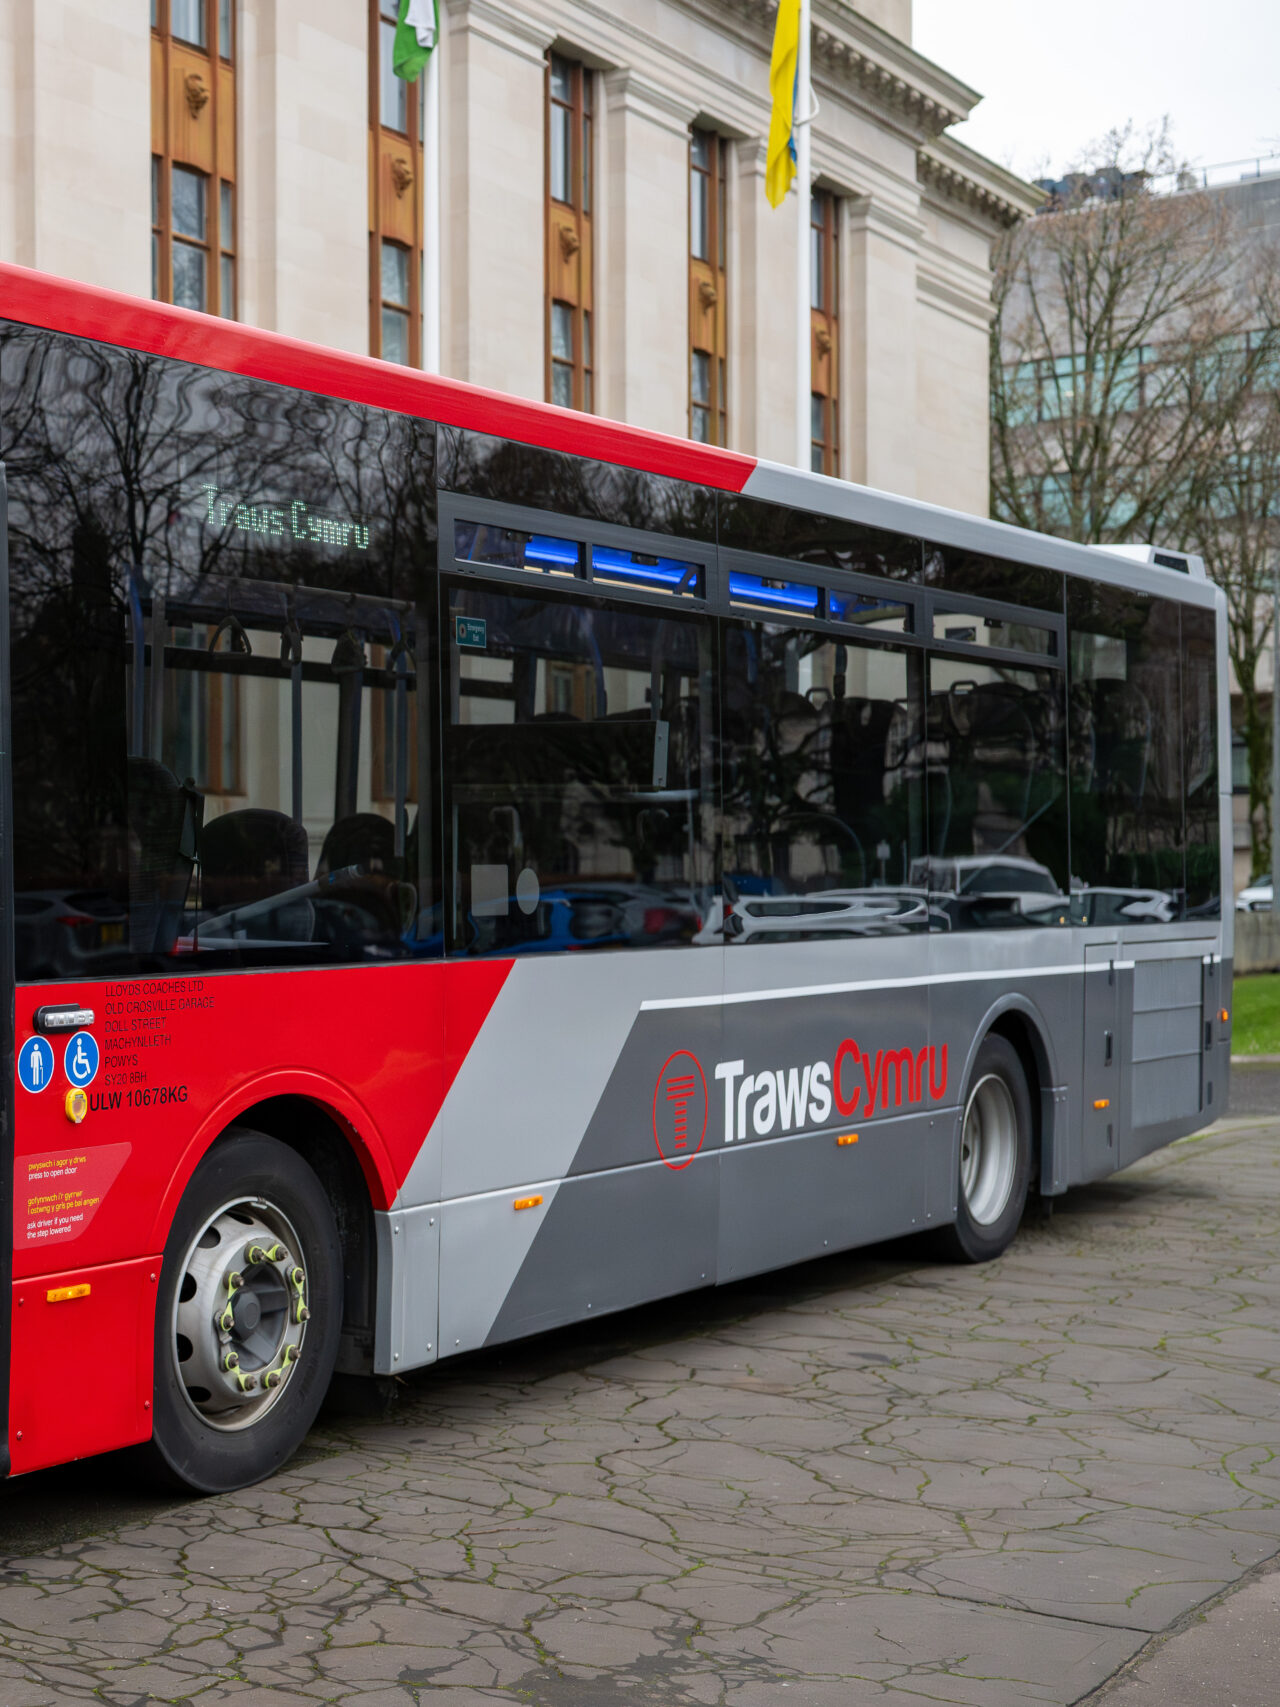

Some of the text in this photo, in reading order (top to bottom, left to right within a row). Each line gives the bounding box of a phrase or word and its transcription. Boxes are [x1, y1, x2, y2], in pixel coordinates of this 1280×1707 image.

[105, 980, 204, 997] LLOYDS COACHES LTD
[105, 996, 215, 1015] OLD CROSVILLE GARAGE
[105, 1016, 167, 1033] DOLL STREET
[104, 1034, 172, 1051] MACHYNLLETH
[104, 1054, 138, 1069] POWYS
[105, 1071, 147, 1086] SY20 8BH
[90, 1085, 188, 1111] ULW 10678KG
[714, 1037, 948, 1143] TrawsCymru
[28, 1160, 53, 1171] pwyswch
[56, 1158, 68, 1168] agor
[73, 1156, 87, 1164] drws
[28, 1166, 78, 1182] press to open door
[66, 1201, 74, 1211] pe
[83, 1197, 100, 1207] angen
[27, 1221, 36, 1230] ask
[37, 1218, 53, 1228] driver
[58, 1216, 69, 1226] you
[69, 1213, 84, 1222] need
[26, 1224, 72, 1239] the step lowered
